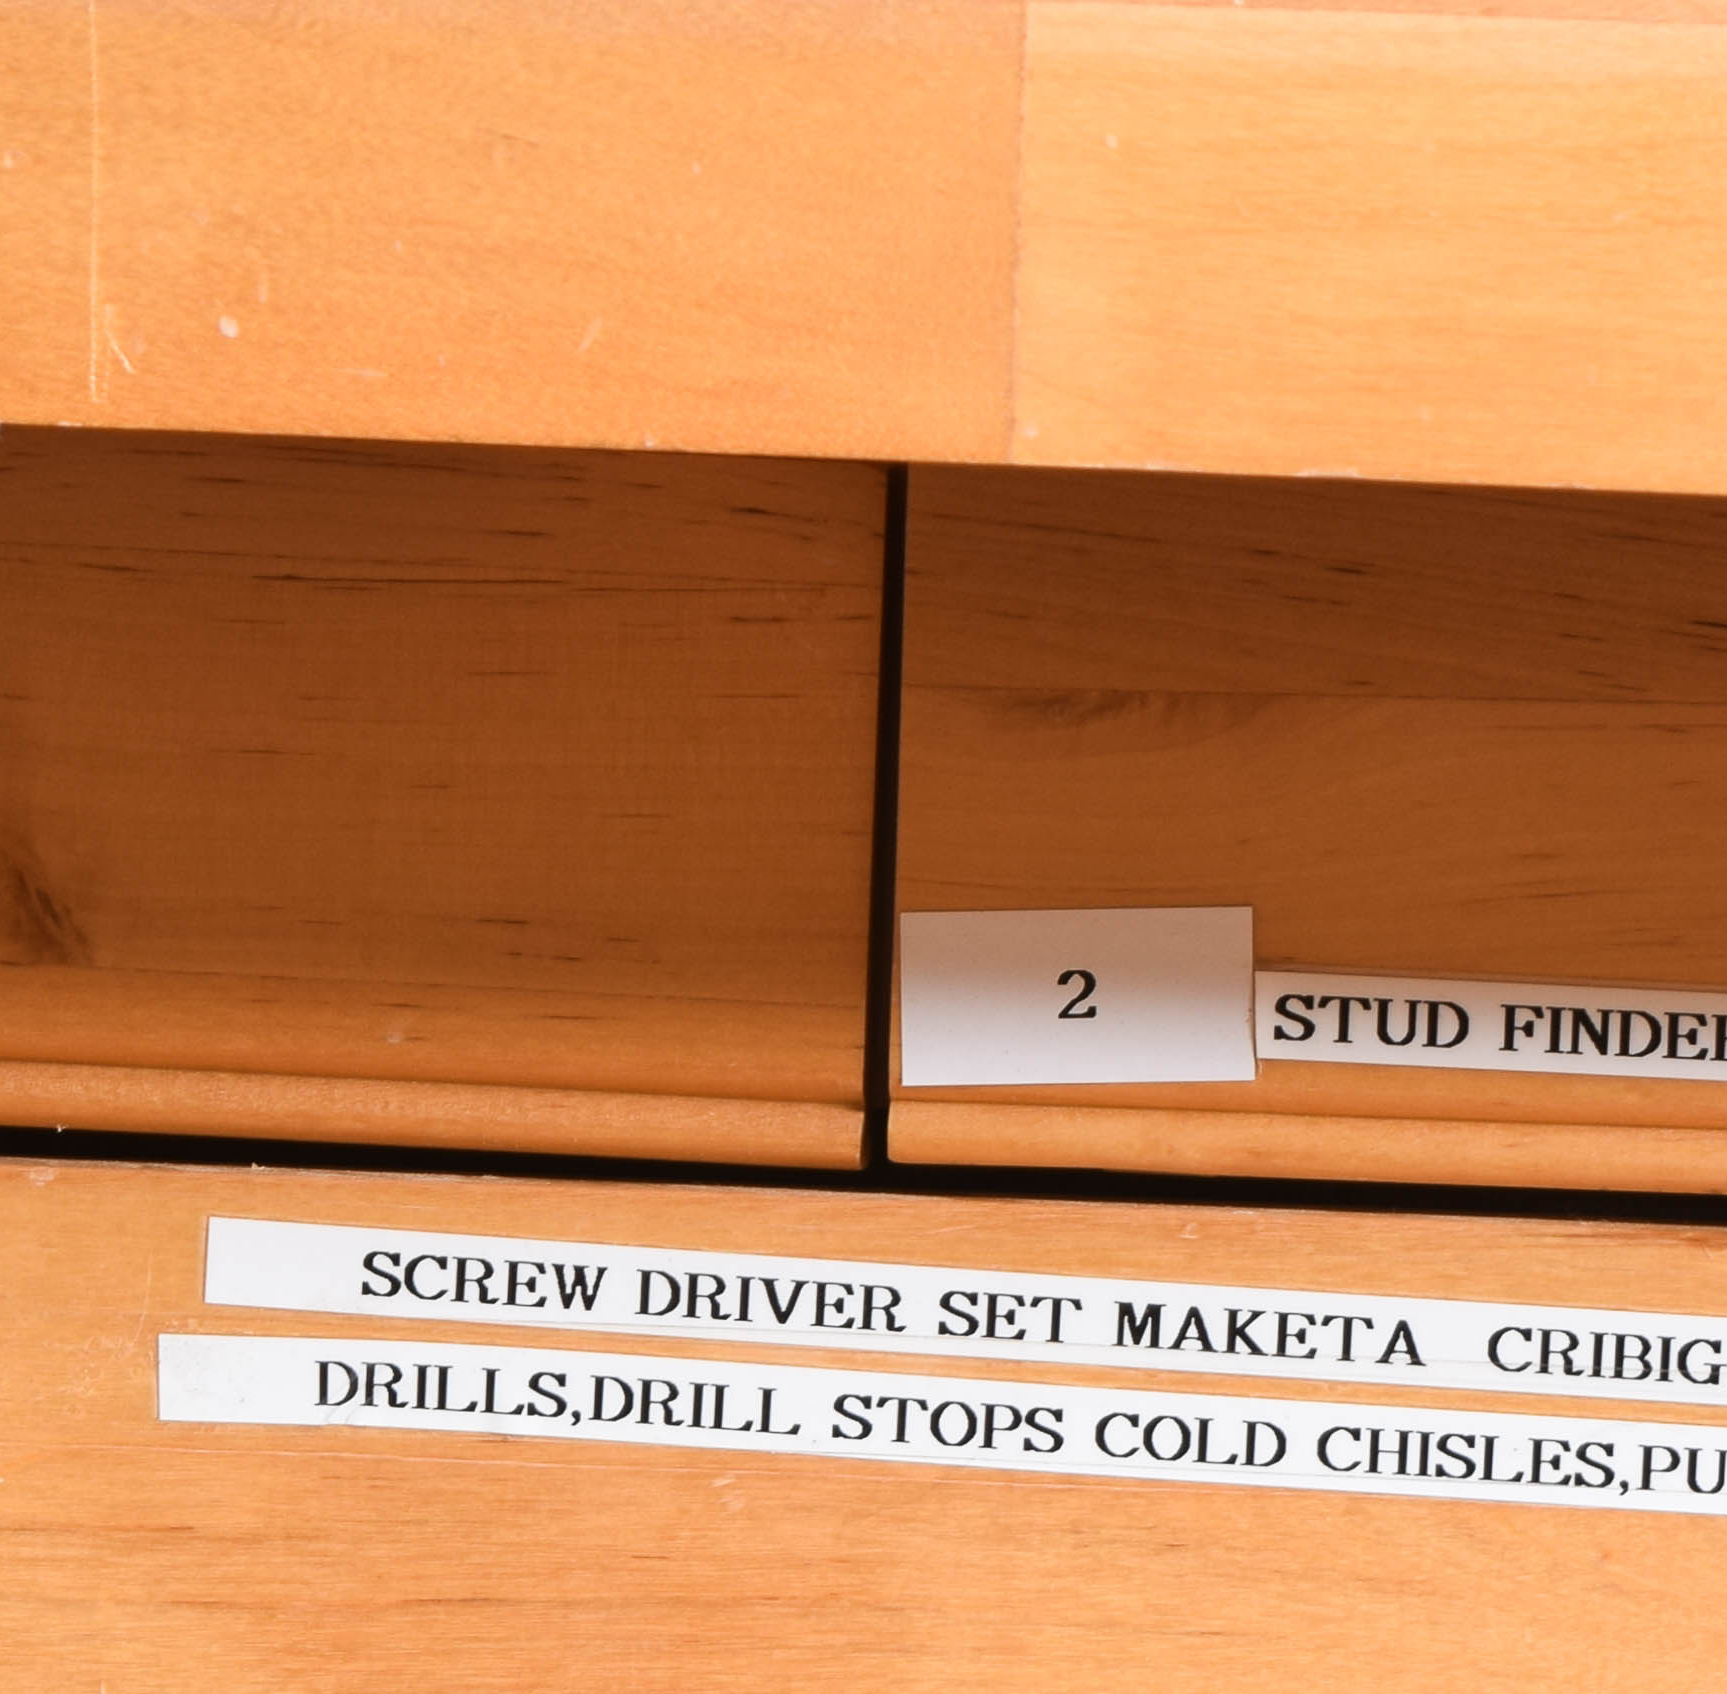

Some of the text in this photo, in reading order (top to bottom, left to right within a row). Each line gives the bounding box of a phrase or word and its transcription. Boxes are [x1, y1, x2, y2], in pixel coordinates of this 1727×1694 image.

[1056, 969, 1098, 1020] 2
[1273, 993, 1470, 1049] STUD
[361, 1250, 608, 1312] SCREW
[634, 1268, 907, 1333] DRIVER
[937, 1290, 1083, 1344] SET
[1112, 1300, 1427, 1367] MAKETA
[831, 1393, 1065, 1454] STOPS
[1094, 1412, 1287, 1468] COLD
